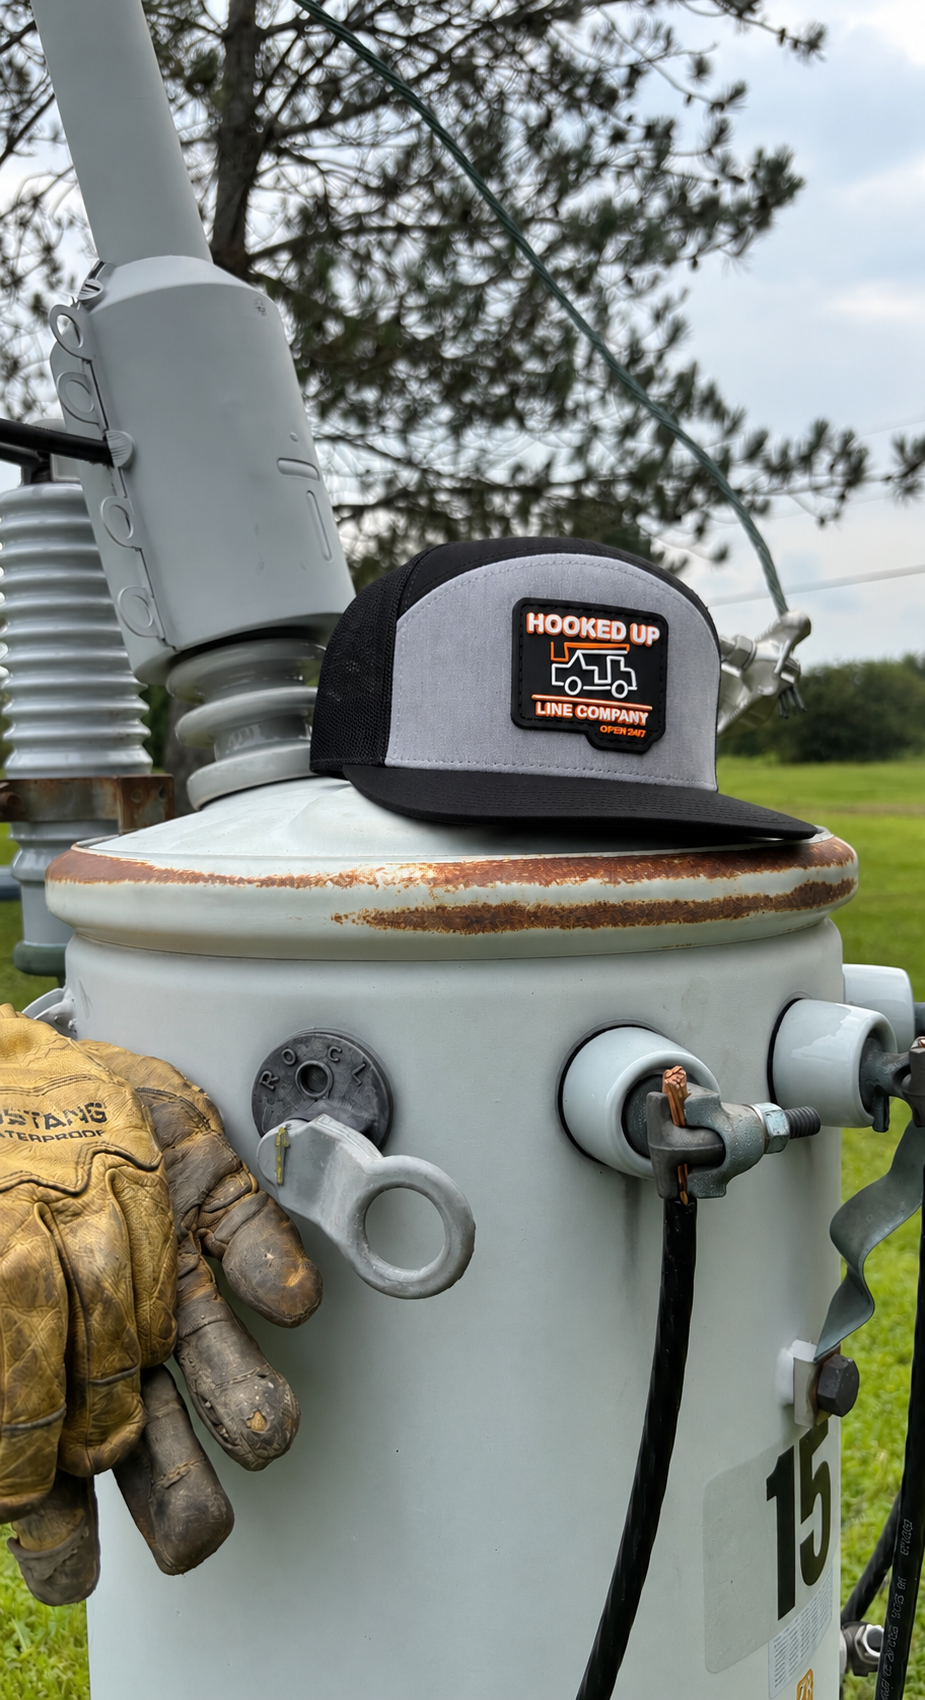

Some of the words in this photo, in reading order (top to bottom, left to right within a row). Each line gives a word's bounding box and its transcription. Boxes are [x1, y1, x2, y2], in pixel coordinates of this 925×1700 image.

[526, 612, 627, 642] HOOKED
[629, 622, 661, 647] UP
[535, 701, 573, 718] LINE
[574, 705, 649, 727] COMPANY
[599, 725, 627, 736] OPEN
[627, 728, 647, 738] 24/7
[765, 1416, 832, 1622] 15
